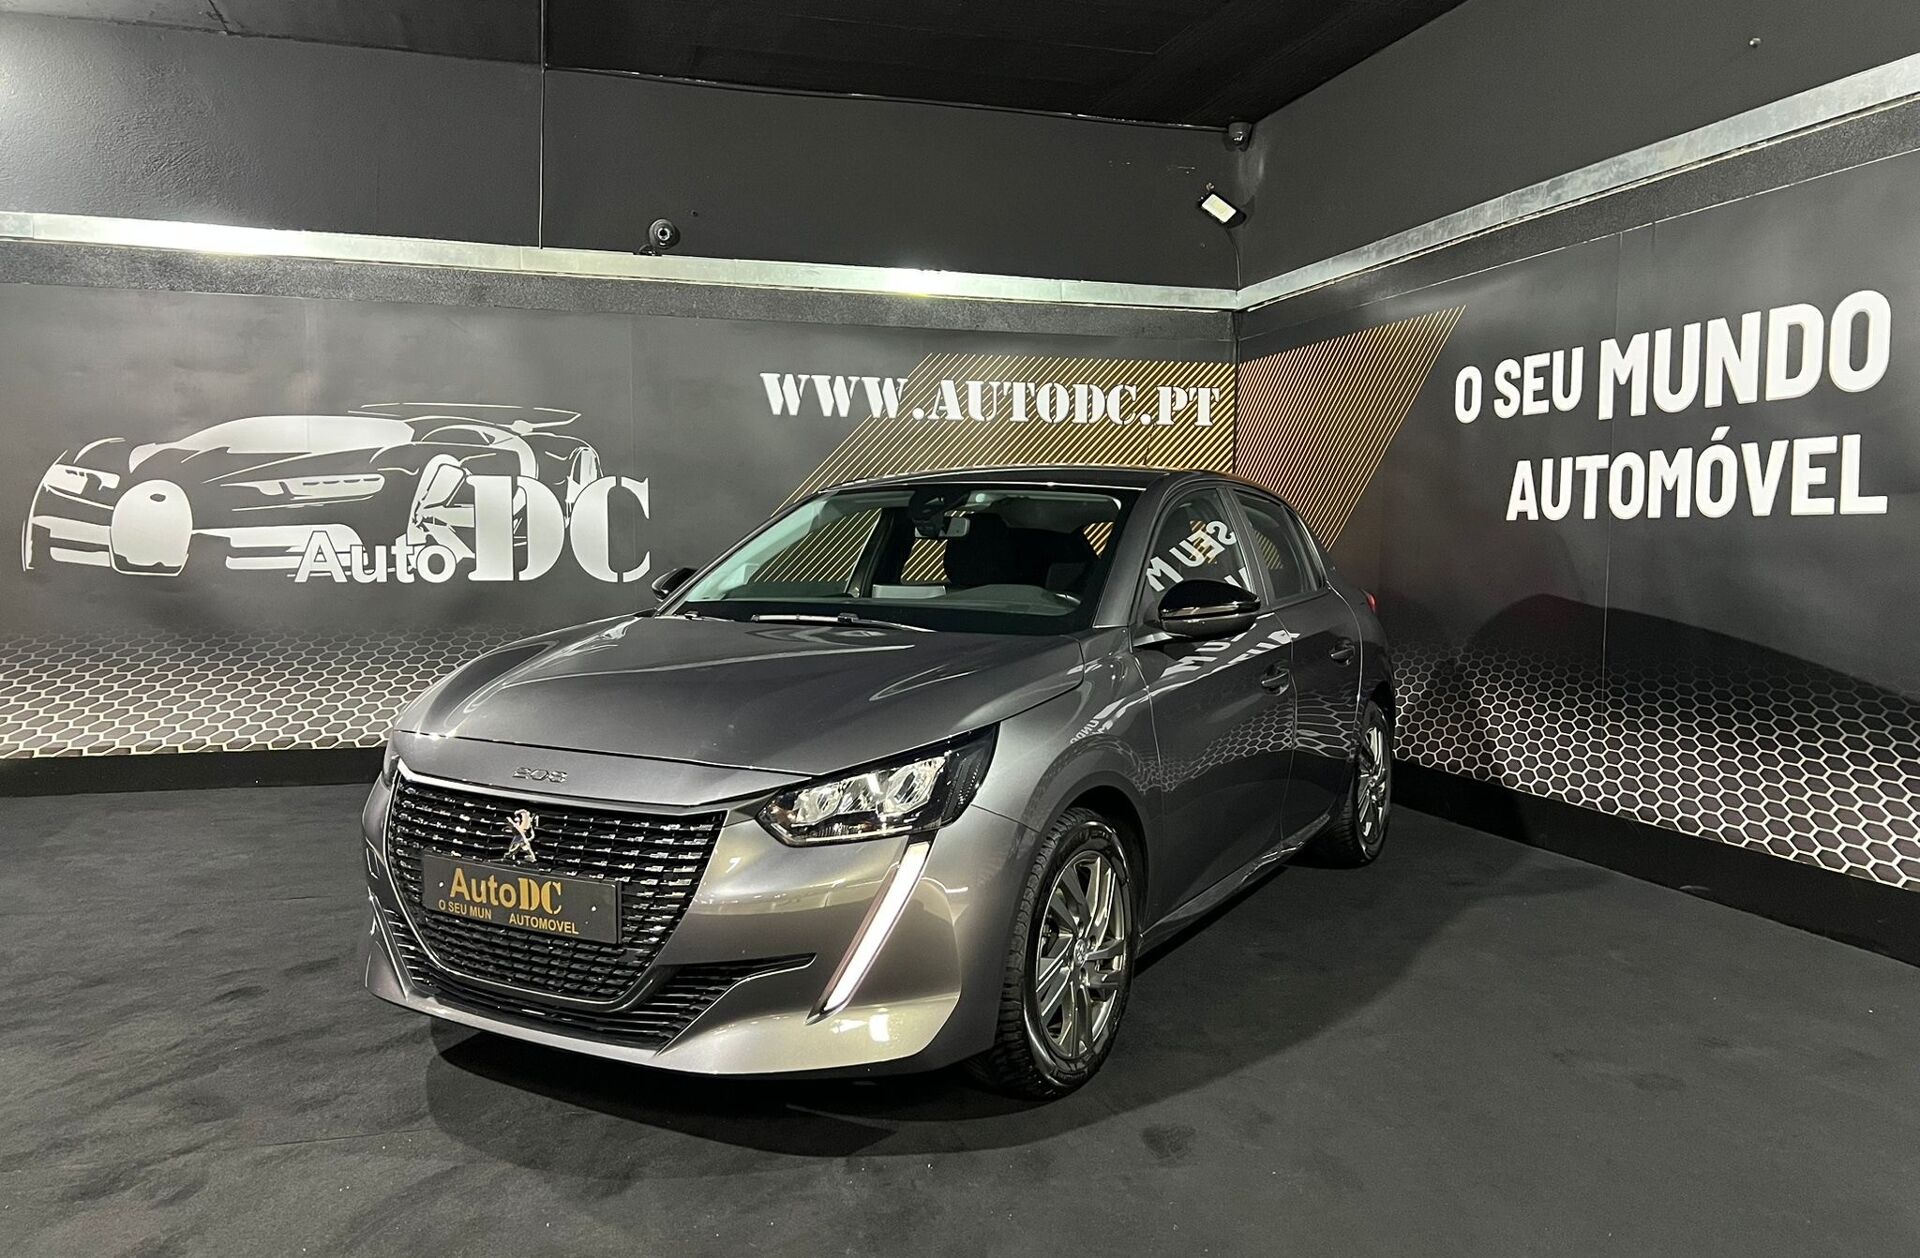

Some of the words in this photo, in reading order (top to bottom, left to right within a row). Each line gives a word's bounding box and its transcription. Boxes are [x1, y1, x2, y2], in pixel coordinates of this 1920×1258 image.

[1454, 365, 1483, 424] O
[1493, 346, 1585, 419] SEU
[1598, 289, 1892, 421] MUNDO
[760, 372, 1222, 427] WWW.AUTODC.PT
[1506, 426, 1889, 522] AUTOMÓVEL
[512, 766, 568, 784] 208
[438, 899, 447, 911] O
[448, 901, 468, 915] SEU
[509, 913, 580, 935] AUTOMOVEL
